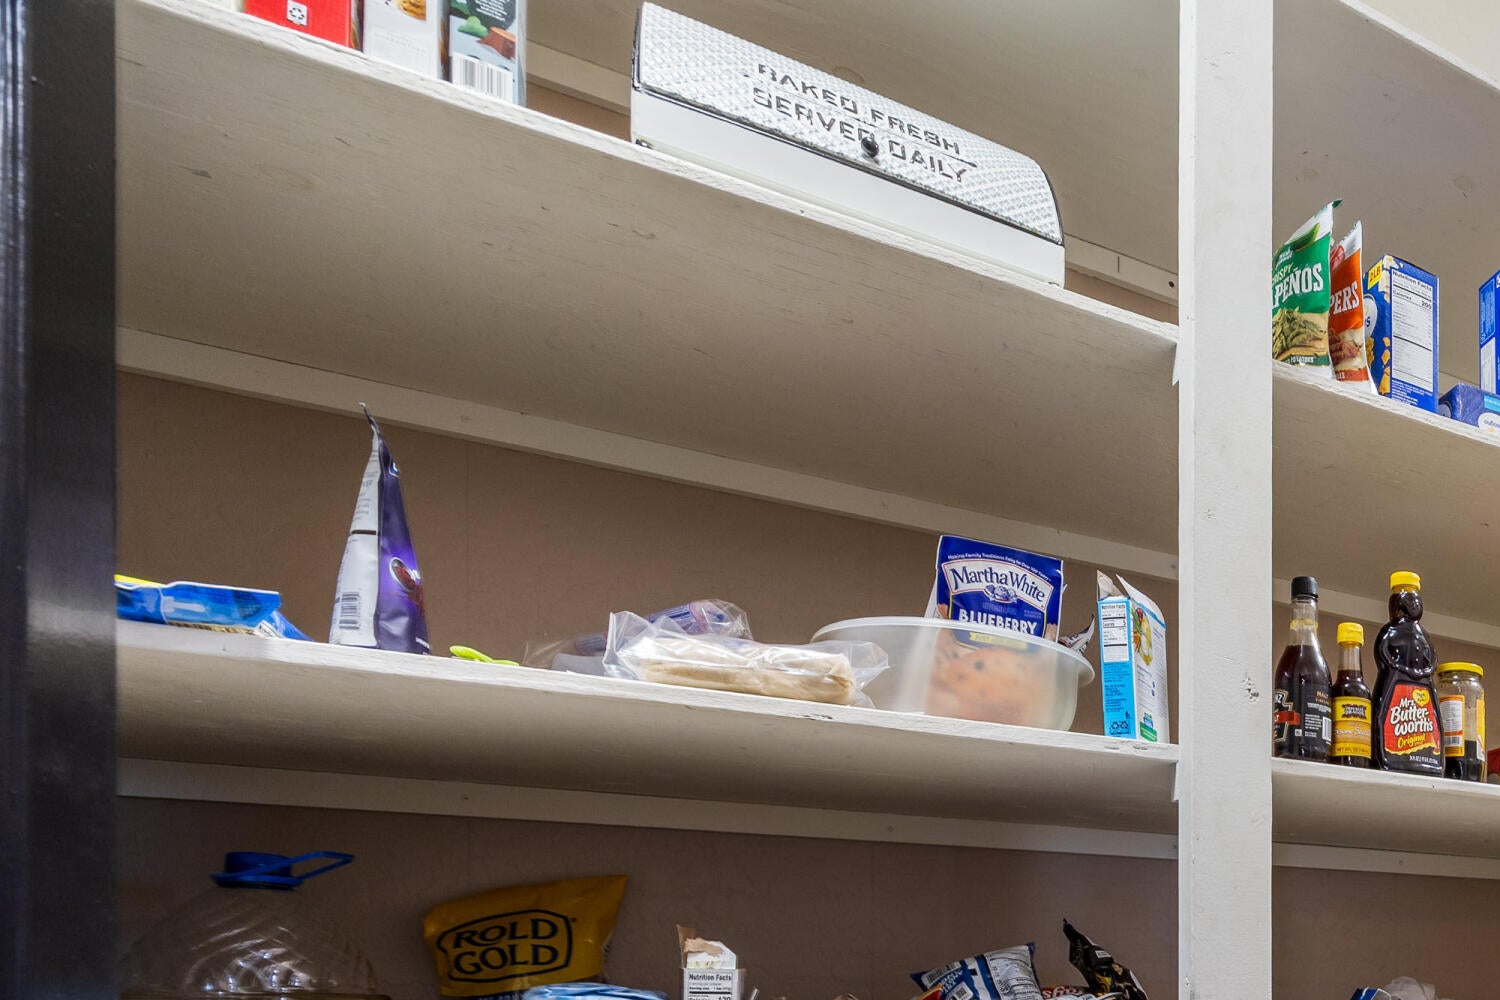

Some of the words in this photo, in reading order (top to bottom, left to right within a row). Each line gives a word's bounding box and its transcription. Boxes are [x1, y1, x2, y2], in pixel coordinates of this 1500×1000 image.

[758, 64, 858, 116] BAKED
[871, 109, 960, 155] FRESH
[888, 139, 969, 183] DAILY
[950, 566, 1008, 590] Martha
[1009, 571, 1045, 603] White
[959, 608, 1037, 635] BLUEBERRY
[1390, 706, 1430, 725] Butter-
[454, 918, 558, 949] ROLD
[454, 944, 559, 975] GOLD
